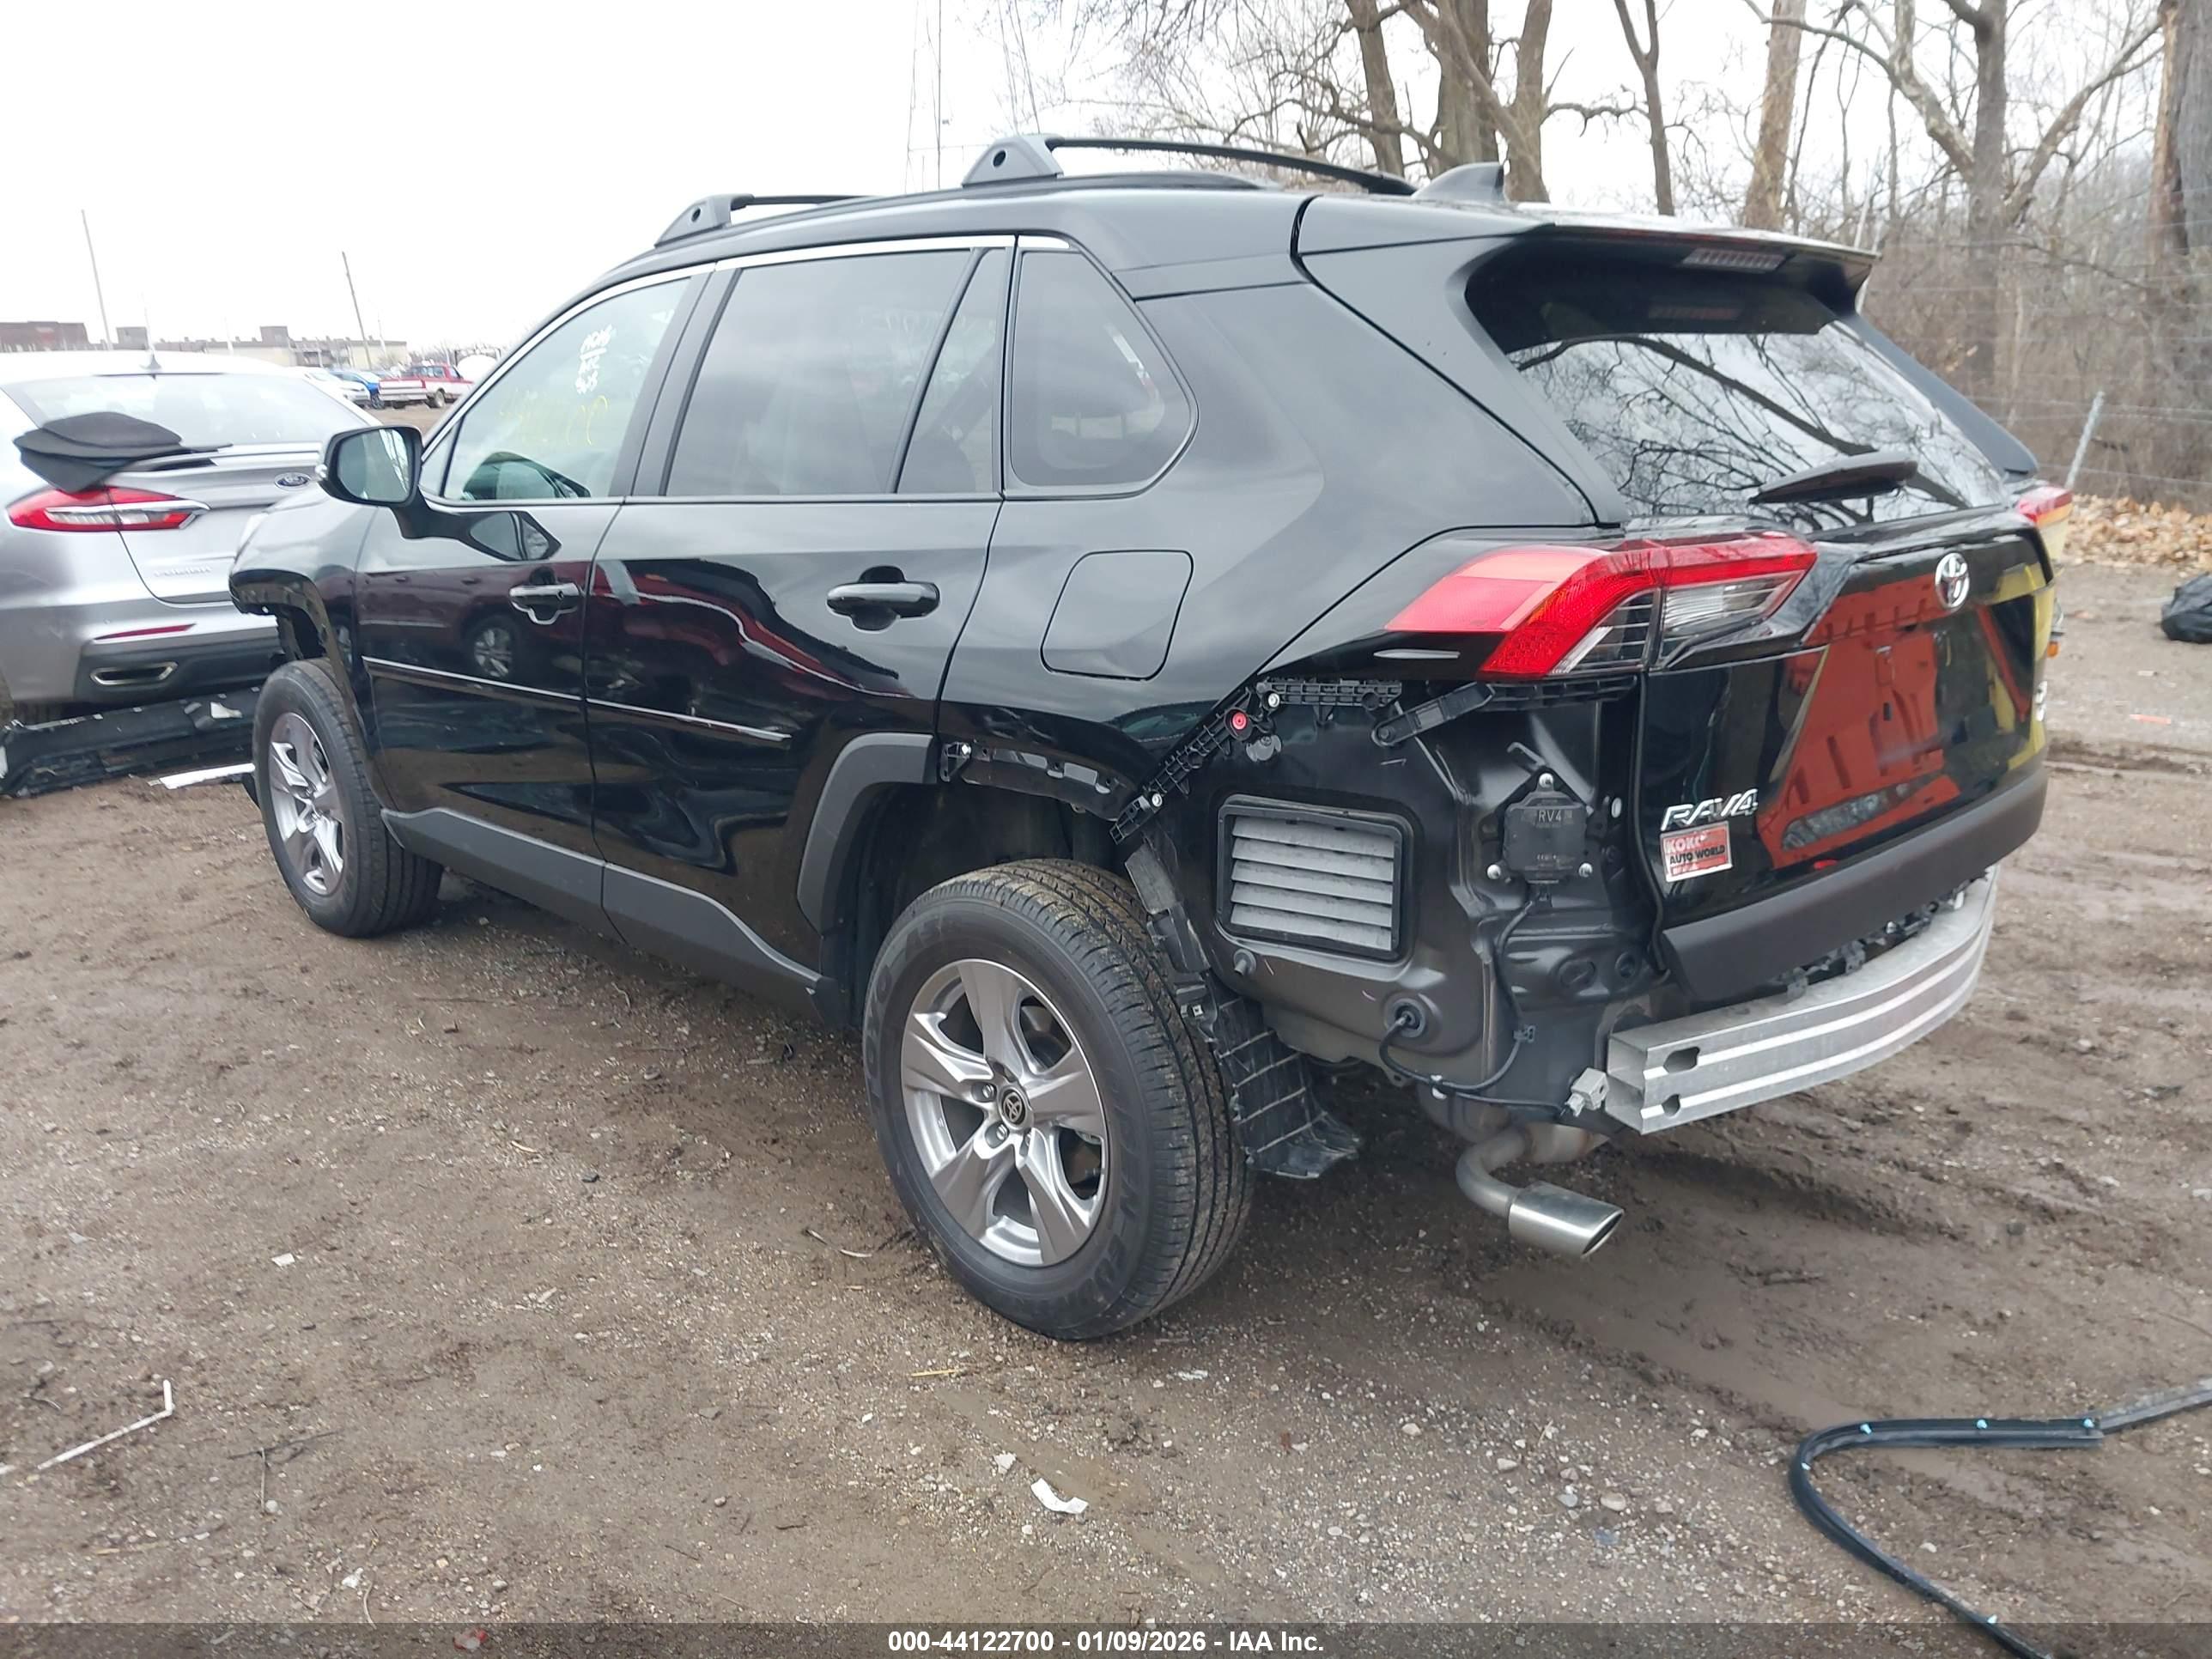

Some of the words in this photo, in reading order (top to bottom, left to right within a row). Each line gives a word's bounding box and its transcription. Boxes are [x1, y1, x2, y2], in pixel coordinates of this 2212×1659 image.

[1538, 810, 1562, 823] RV4
[1661, 788, 1759, 831] RAV4
[1669, 852, 1693, 865] AUTO
[1694, 844, 1726, 860] WORLD
